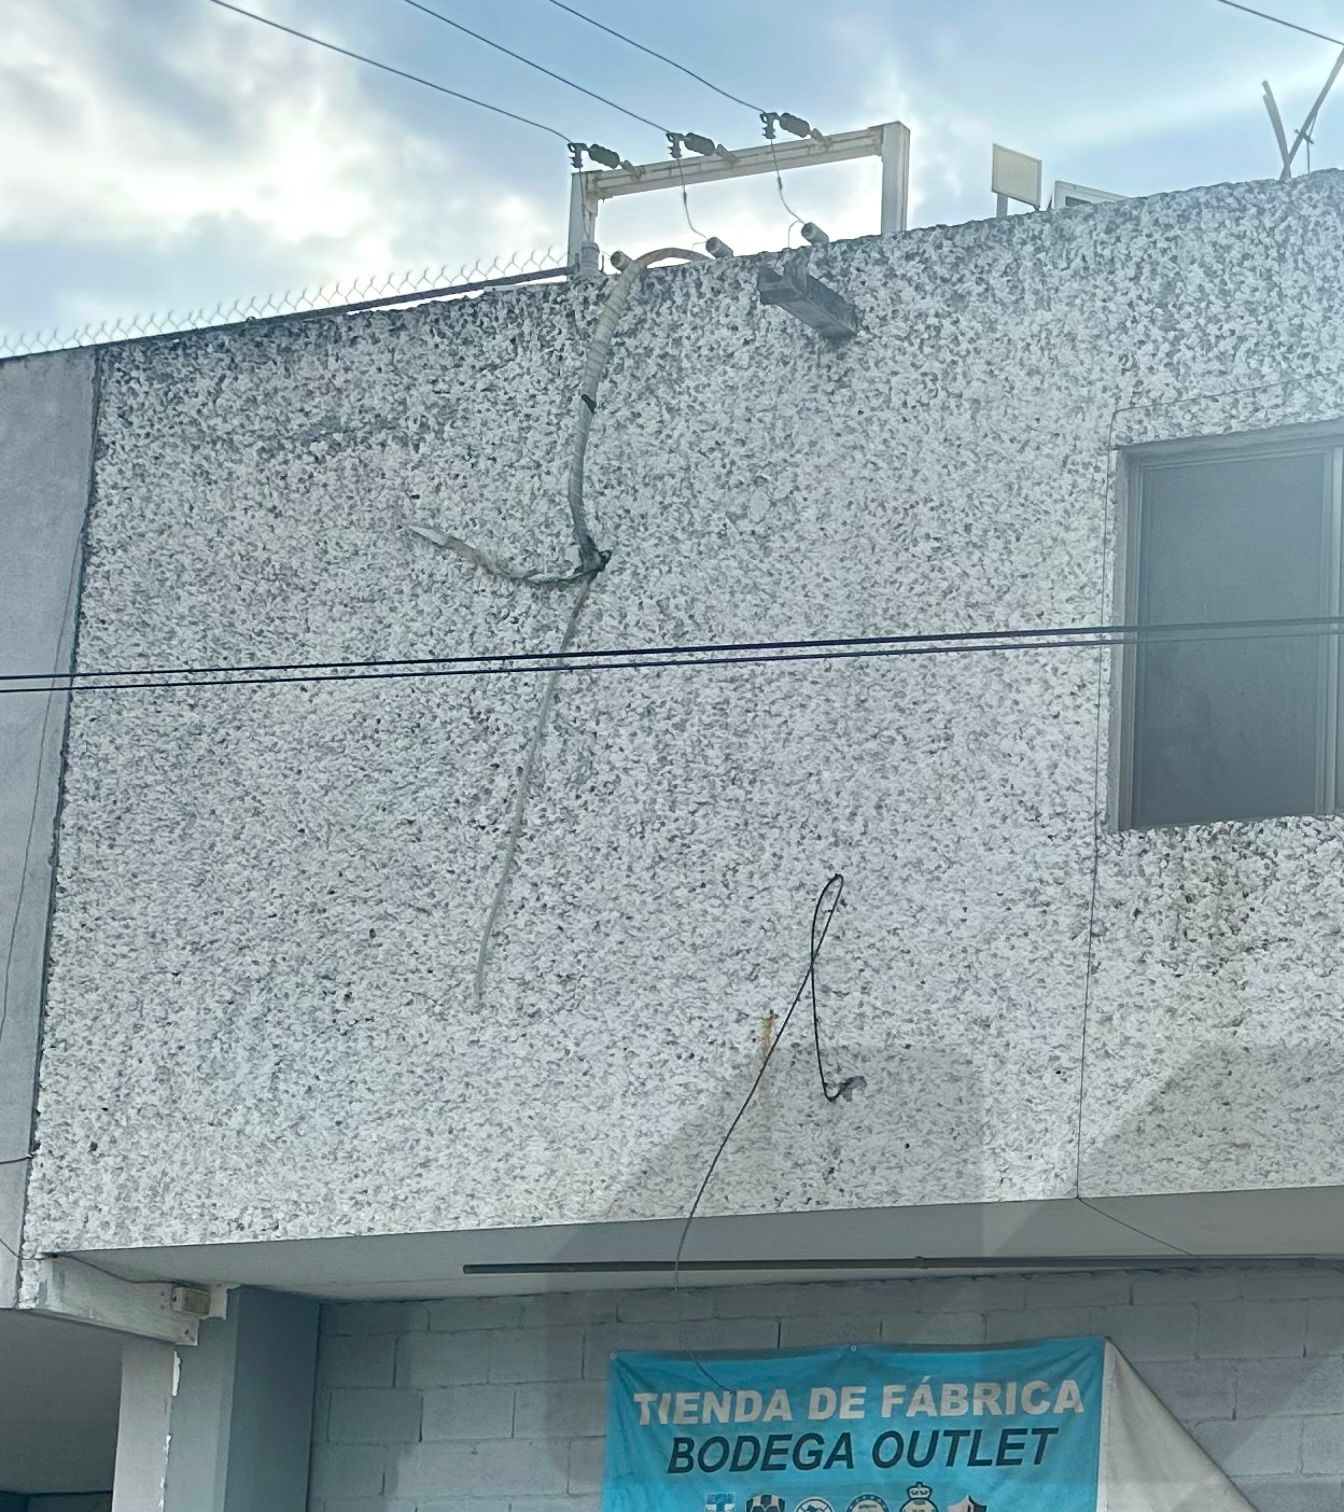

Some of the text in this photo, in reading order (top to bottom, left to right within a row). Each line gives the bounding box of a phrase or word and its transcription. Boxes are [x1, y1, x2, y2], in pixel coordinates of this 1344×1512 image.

[633, 1375, 1085, 1426] TIENDA DE FÁBRICA
[667, 1427, 1060, 1474] BODEGA OUTLET
